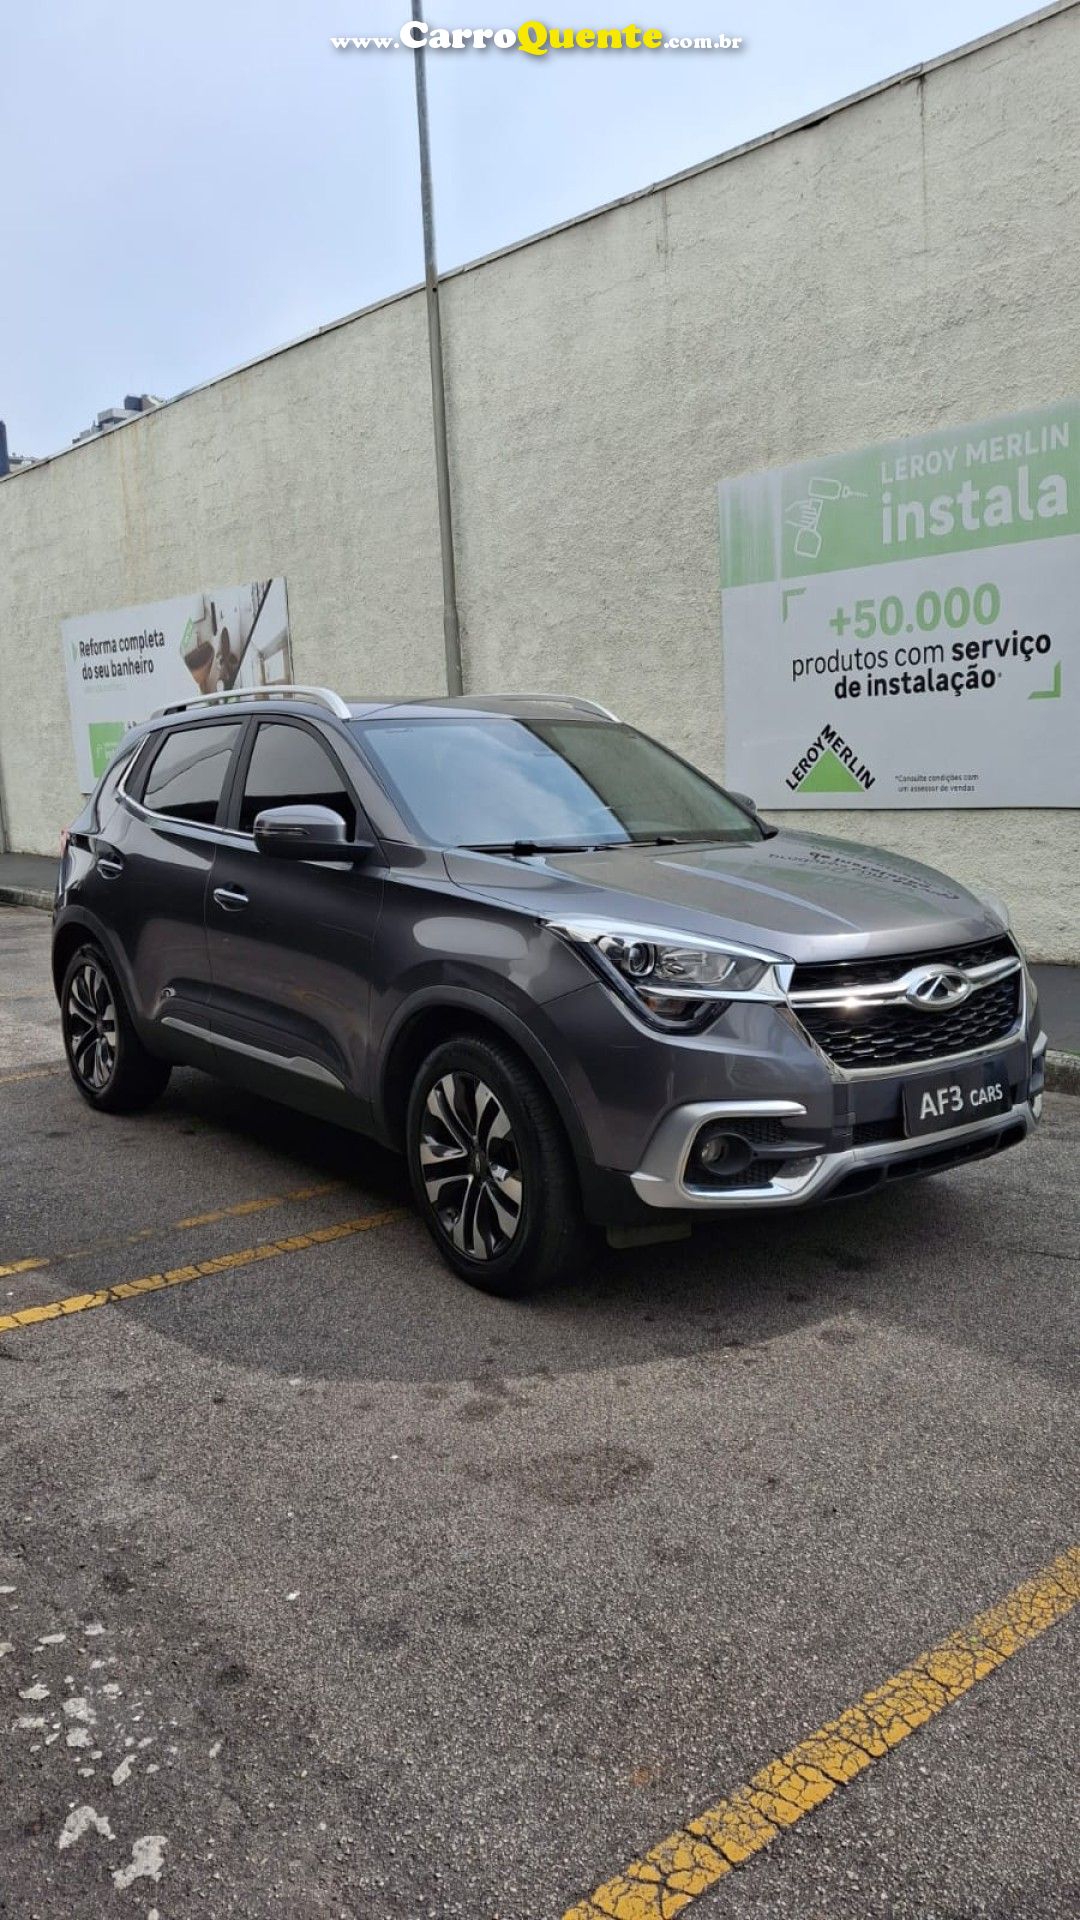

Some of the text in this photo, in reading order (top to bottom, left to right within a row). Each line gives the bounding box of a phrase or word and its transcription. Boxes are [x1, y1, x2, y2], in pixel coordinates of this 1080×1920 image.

[881, 422, 1070, 485] LEROY MERLIN
[882, 465, 1069, 545] instala
[829, 582, 1001, 639] +50.000
[79, 629, 165, 657] Reforma completa
[82, 655, 154, 680] do seu banheiro
[792, 629, 1052, 682] produtos com serviço
[834, 675, 861, 700] de
[785, 724, 876, 791] LEROY MERLIN
[919, 1083, 1003, 1120] AF3 CARS
